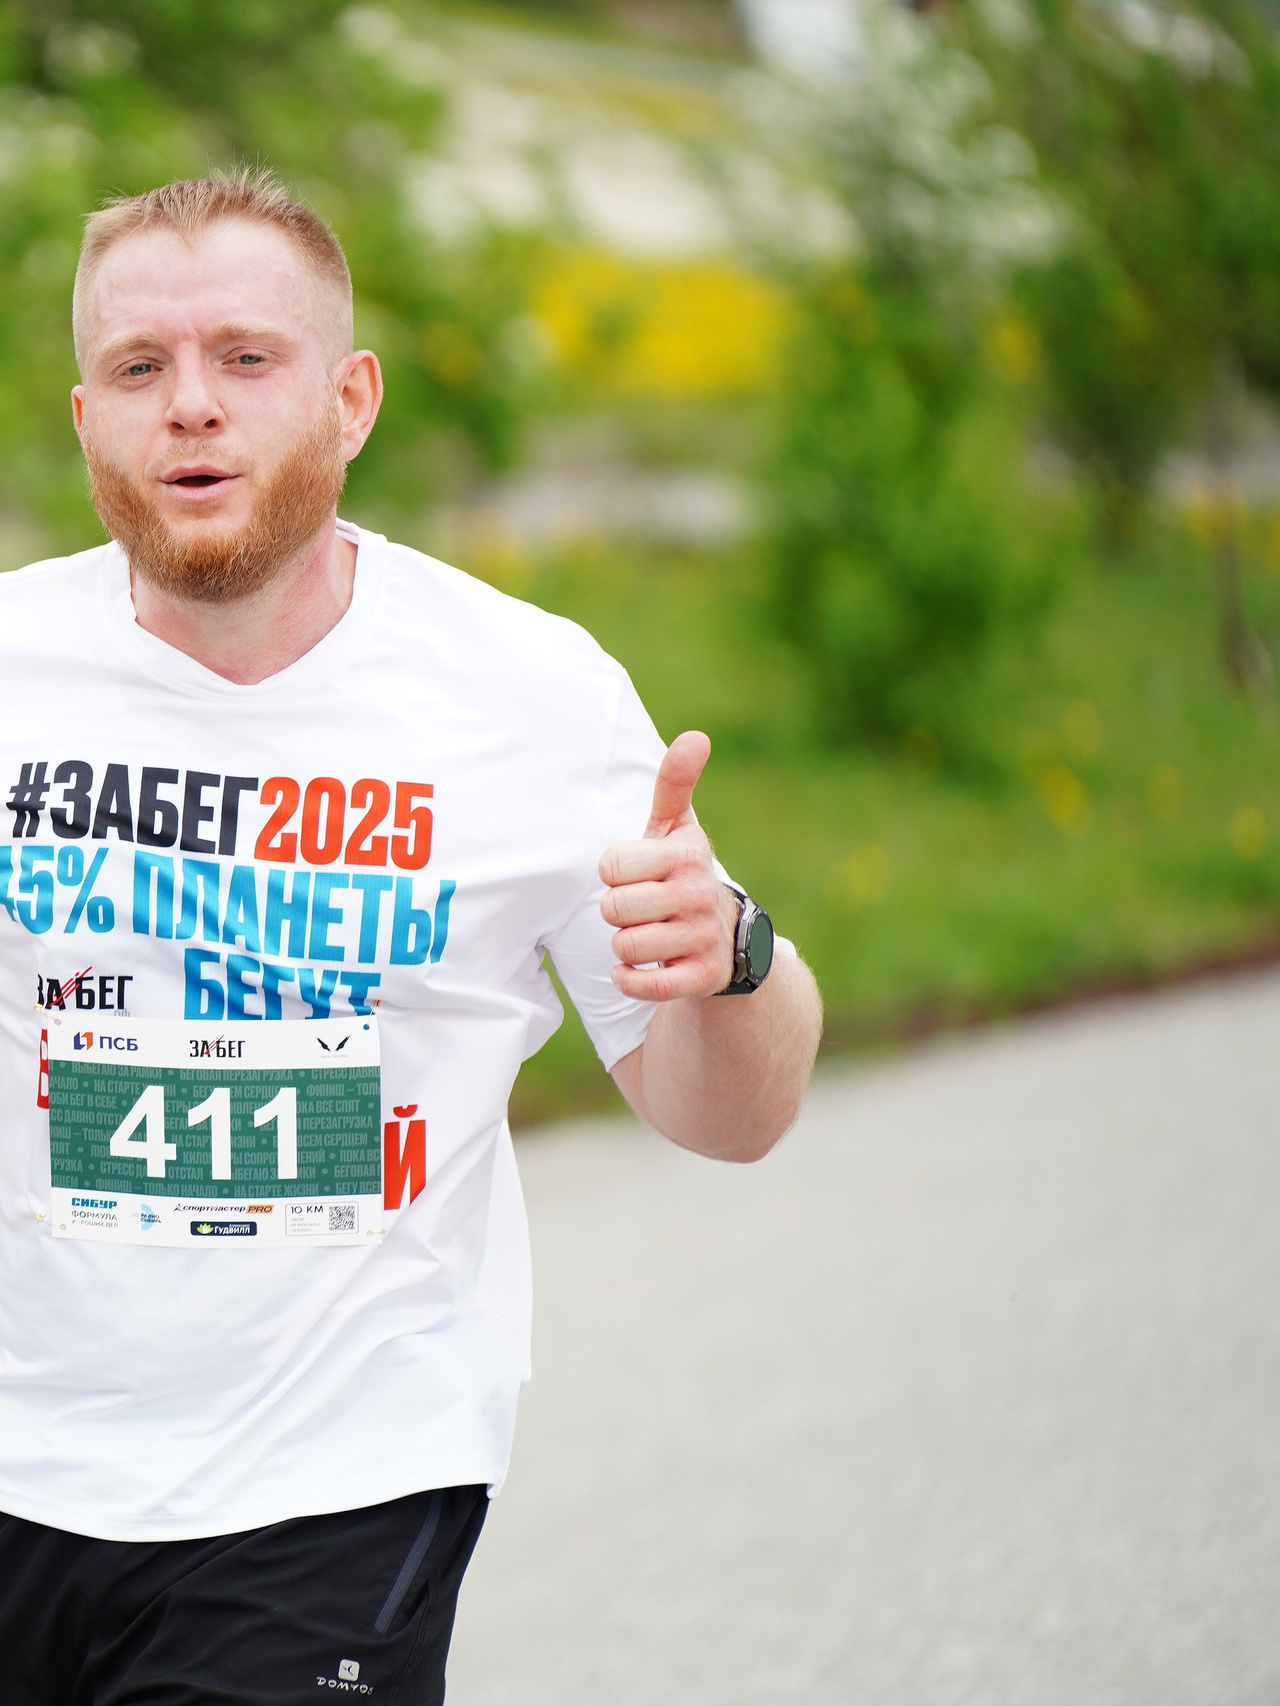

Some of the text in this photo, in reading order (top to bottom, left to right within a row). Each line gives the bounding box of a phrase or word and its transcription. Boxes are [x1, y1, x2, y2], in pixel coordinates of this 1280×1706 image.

[133, 850, 456, 966] ПЛАНЕТЫ
[184, 948, 381, 1021] БЕГУТ
[100, 1036, 139, 1051] ПСБ
[130, 1066, 162, 1079] РАМКИ
[94, 1079, 106, 1092] НА
[107, 1081, 140, 1095] СТАРТЕ
[306, 1083, 345, 1097] ФИНИШ
[70, 1093, 85, 1106] БЕГ
[95, 1096, 118, 1109] СЕБЕ
[316, 1101, 334, 1113] ВСЕ
[335, 1099, 360, 1113] СПЯТ
[64, 1109, 95, 1124] ДАВНО
[303, 1115, 373, 1131] ПЕРЕЗАГРУЗКА
[109, 1084, 298, 1181] 411
[324, 1132, 368, 1148] СЕРДЦЕМ
[339, 1149, 365, 1163] ПОКА
[100, 1161, 134, 1176] СТРЕСС
[168, 1166, 204, 1180] ОТСТАЛ
[334, 1164, 376, 1179] БЕГОВАЯ
[95, 1178, 132, 1193] ФИНИШ
[143, 1181, 179, 1196] ТОЛЬКО
[181, 1183, 219, 1198] НАЧАЛО
[248, 1184, 282, 1198] СТАРТЕ
[284, 1183, 320, 1197] ЖИЗНИ
[71, 1197, 118, 1209] СИБУР
[247, 1205, 273, 1214] PRO
[291, 1205, 303, 1214] 10
[71, 1209, 118, 1221] ФОРМУЛА
[214, 1225, 251, 1235] Гудвилл
